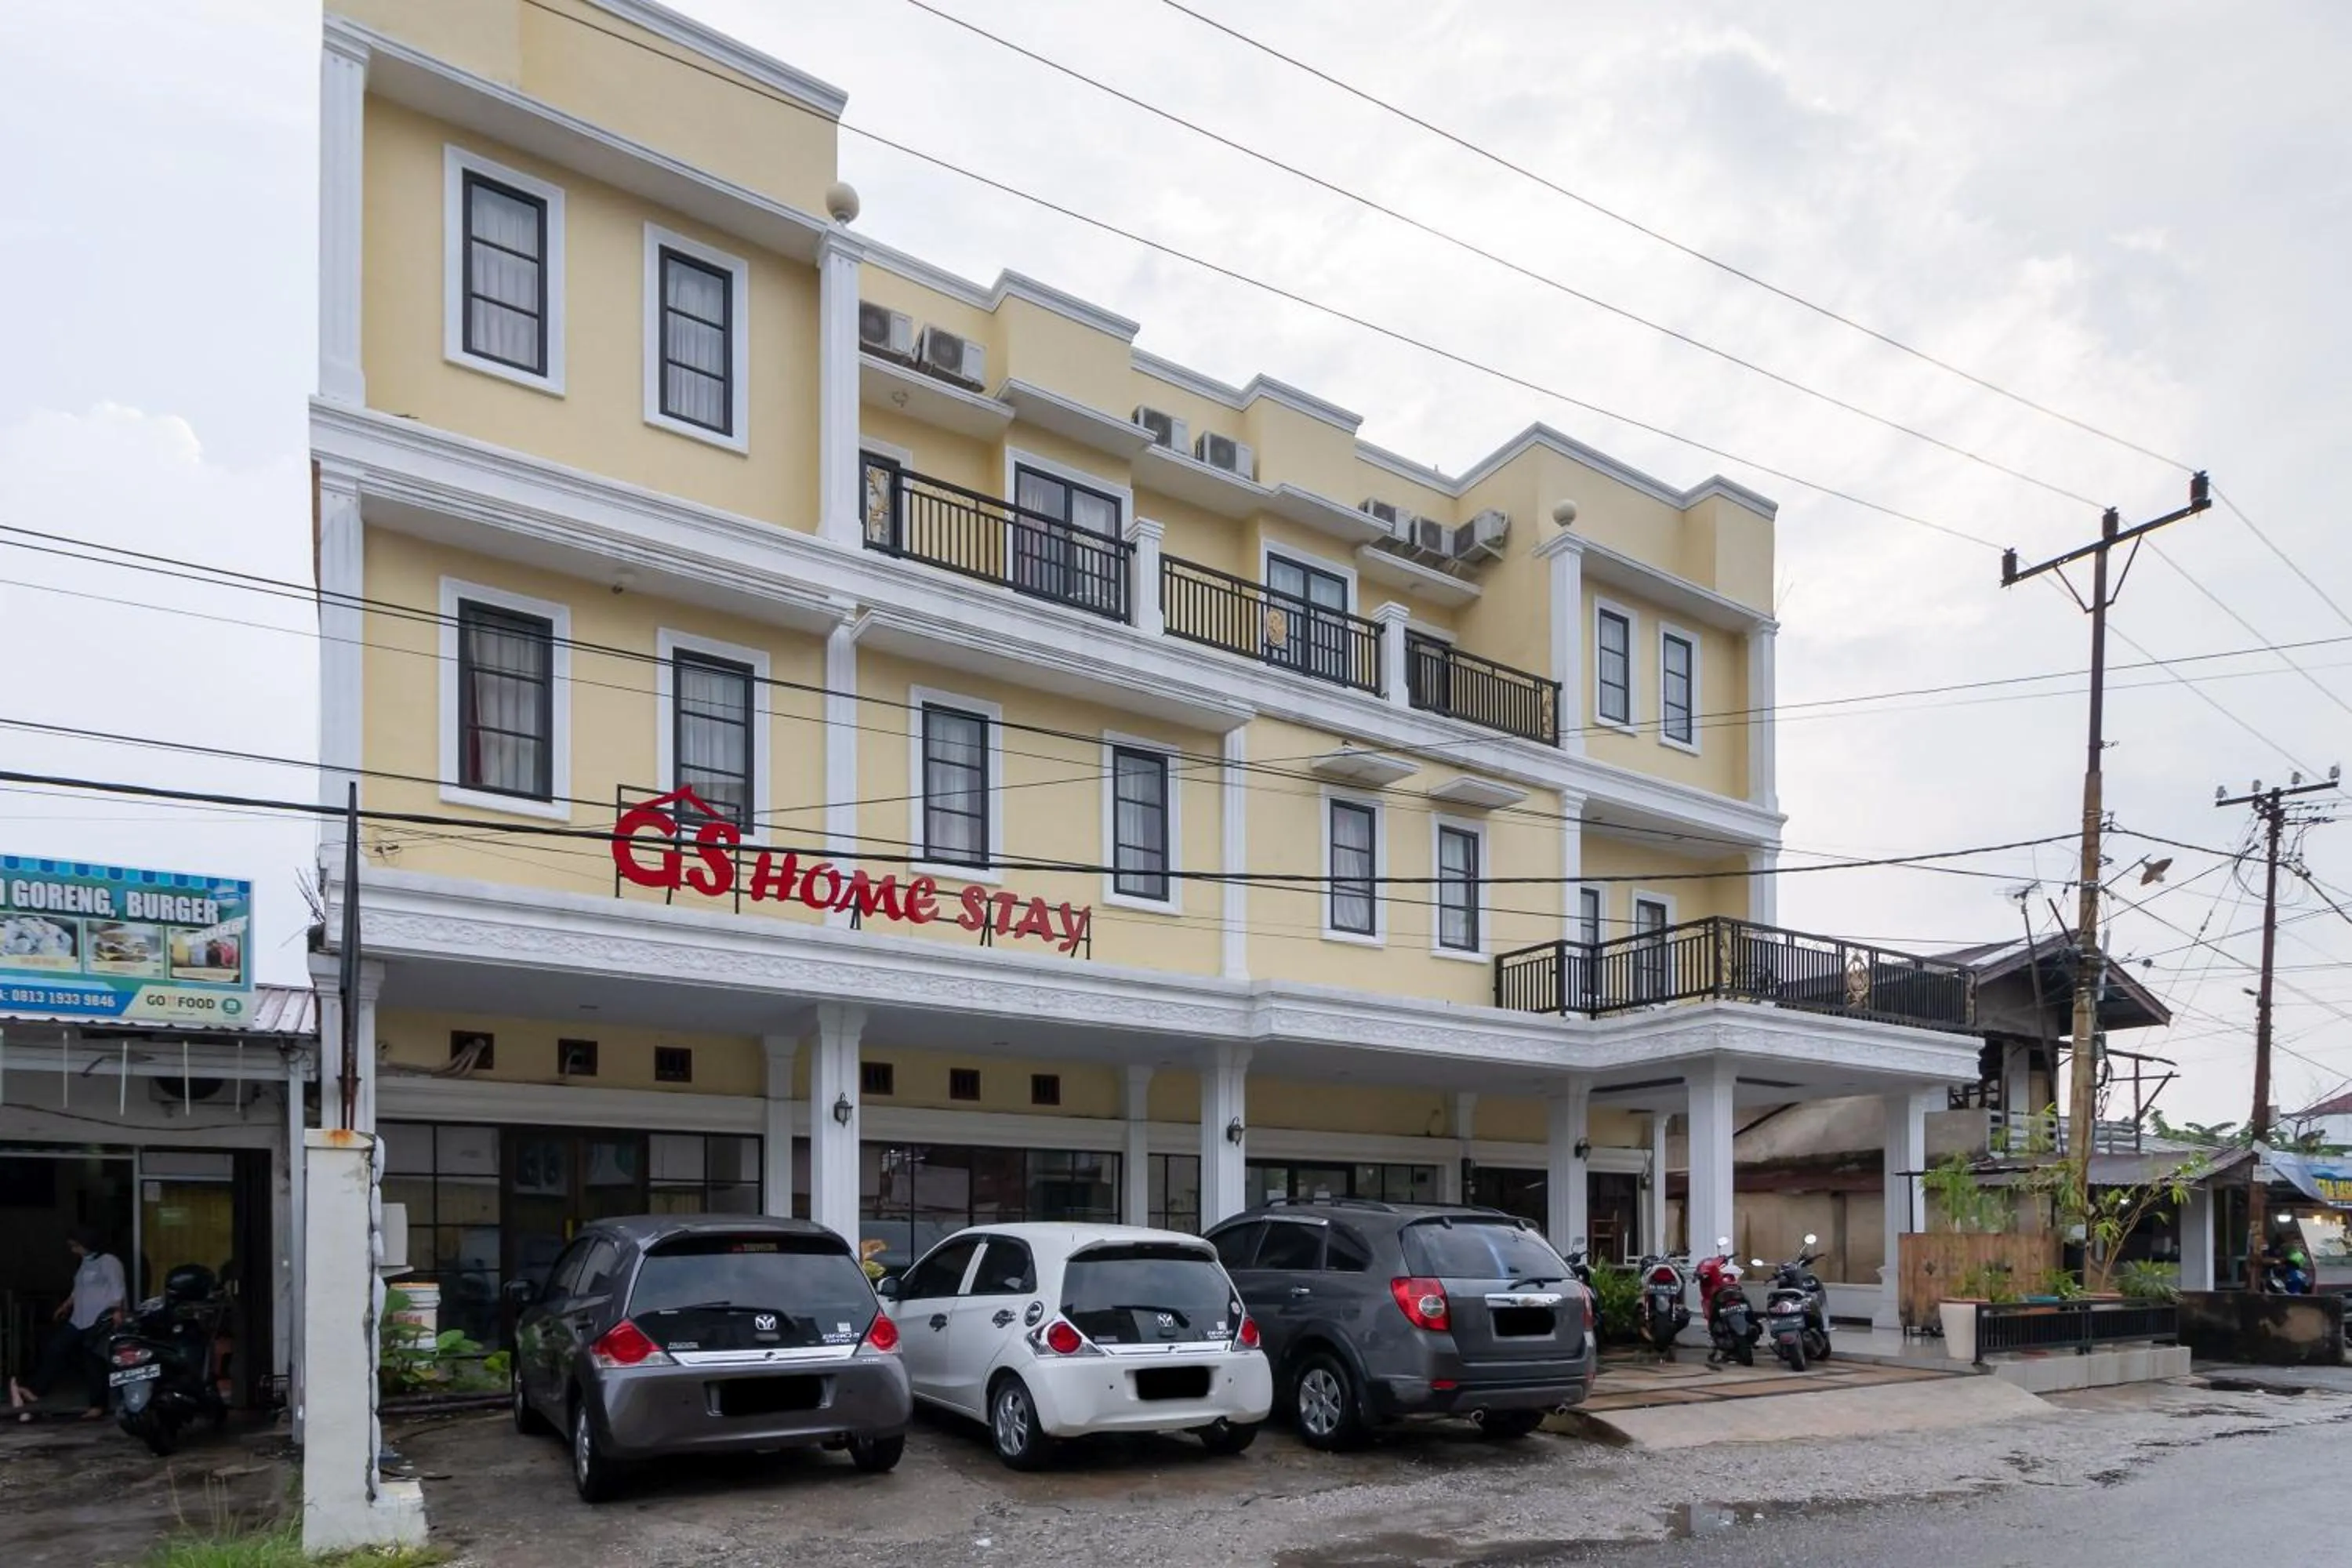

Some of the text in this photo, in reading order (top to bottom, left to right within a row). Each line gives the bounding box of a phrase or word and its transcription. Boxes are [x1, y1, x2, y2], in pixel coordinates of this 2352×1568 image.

[12, 879, 116, 918] GORENG,
[125, 891, 219, 924] BURGER
[612, 808, 741, 897] GS
[956, 885, 1091, 953] STAY
[147, 994, 216, 1009] GO FOOD
